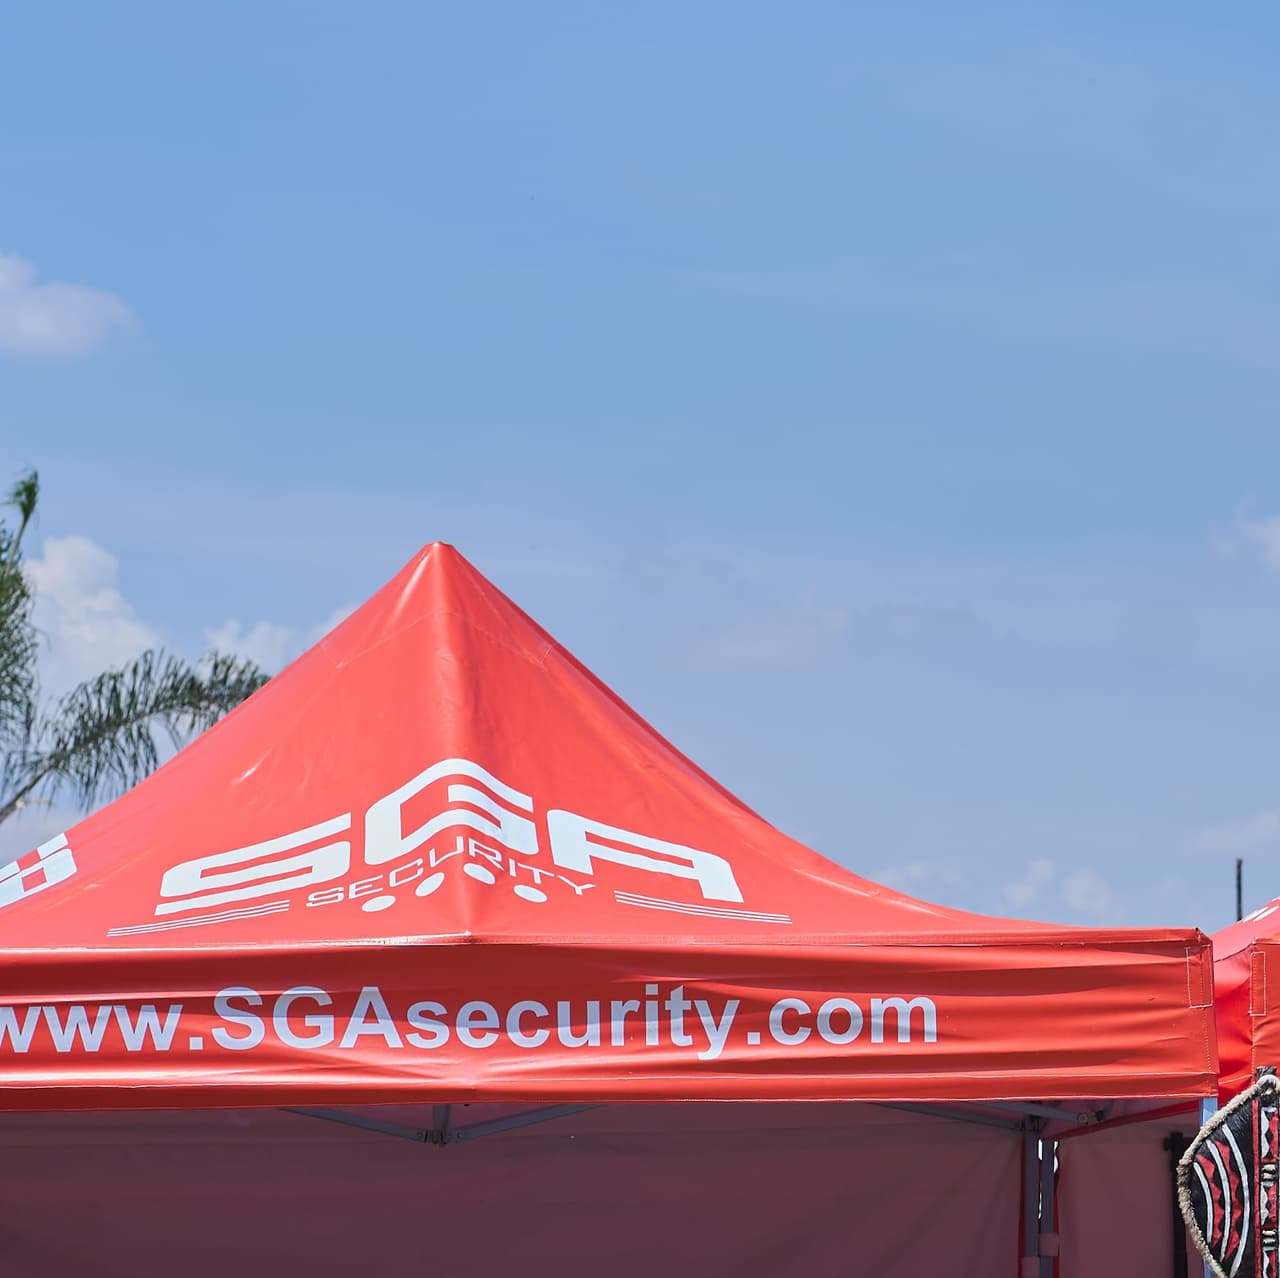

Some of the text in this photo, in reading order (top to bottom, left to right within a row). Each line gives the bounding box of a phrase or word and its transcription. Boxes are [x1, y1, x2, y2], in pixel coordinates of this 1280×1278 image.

[154, 757, 745, 917] SGA
[306, 834, 597, 907] SECURITY
[0, 984, 937, 1061] www.SGAsecurity.com
